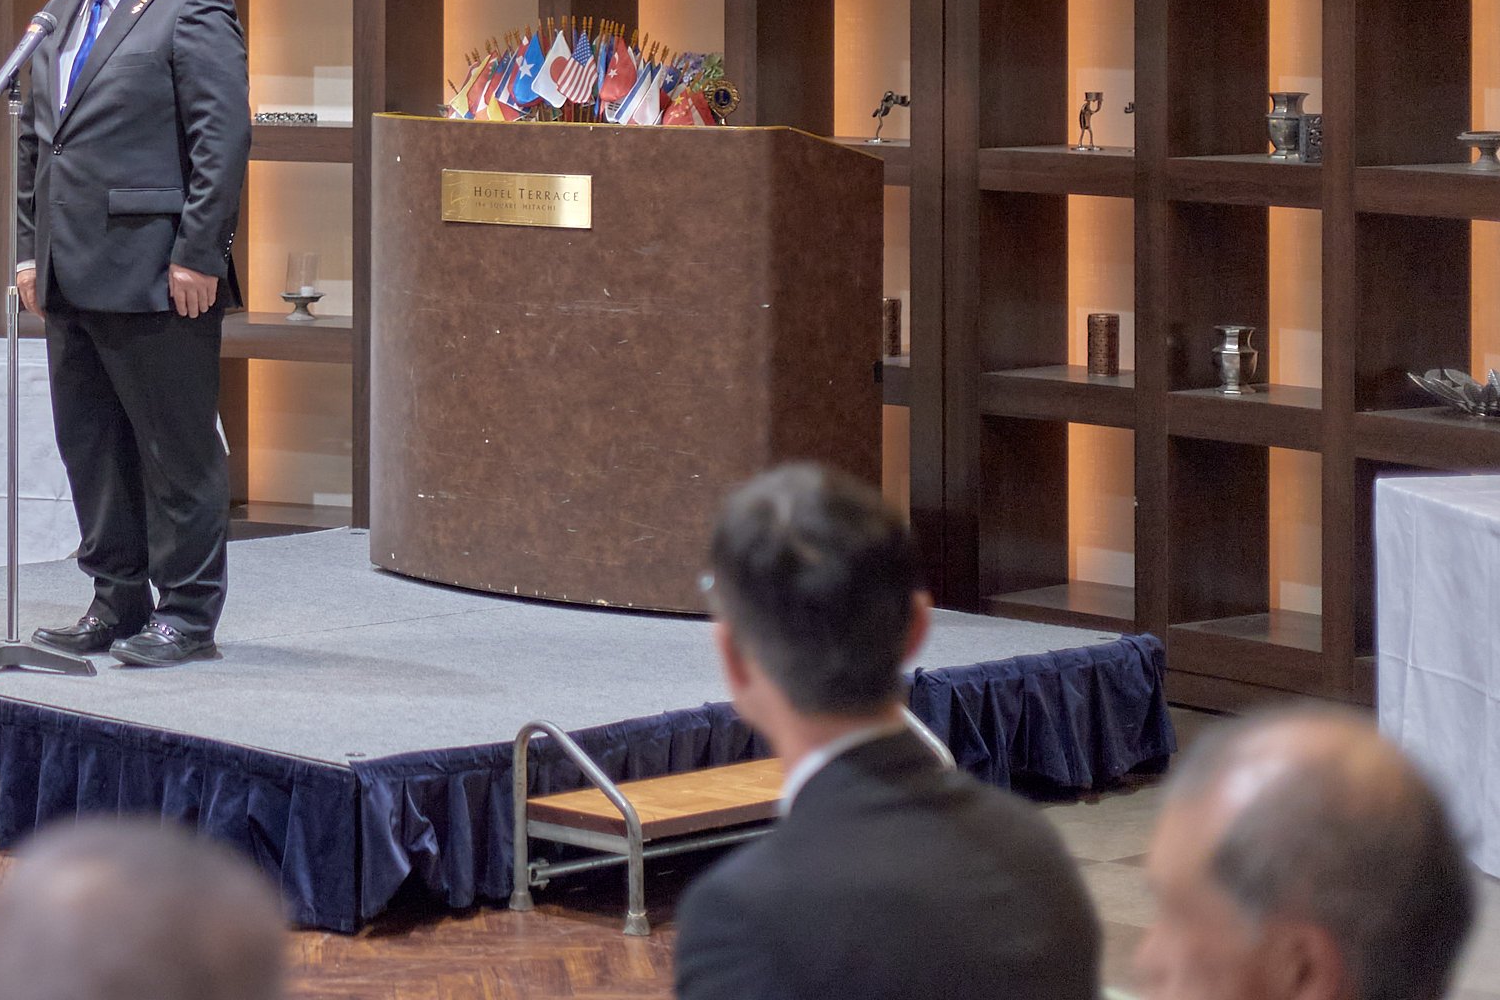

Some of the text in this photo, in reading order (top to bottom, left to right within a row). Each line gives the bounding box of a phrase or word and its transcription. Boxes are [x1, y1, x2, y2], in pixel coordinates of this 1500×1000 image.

[474, 186, 580, 202] HOTEL TERRACE
[489, 202, 518, 210] SQUARE
[522, 203, 556, 211] HITACHI
